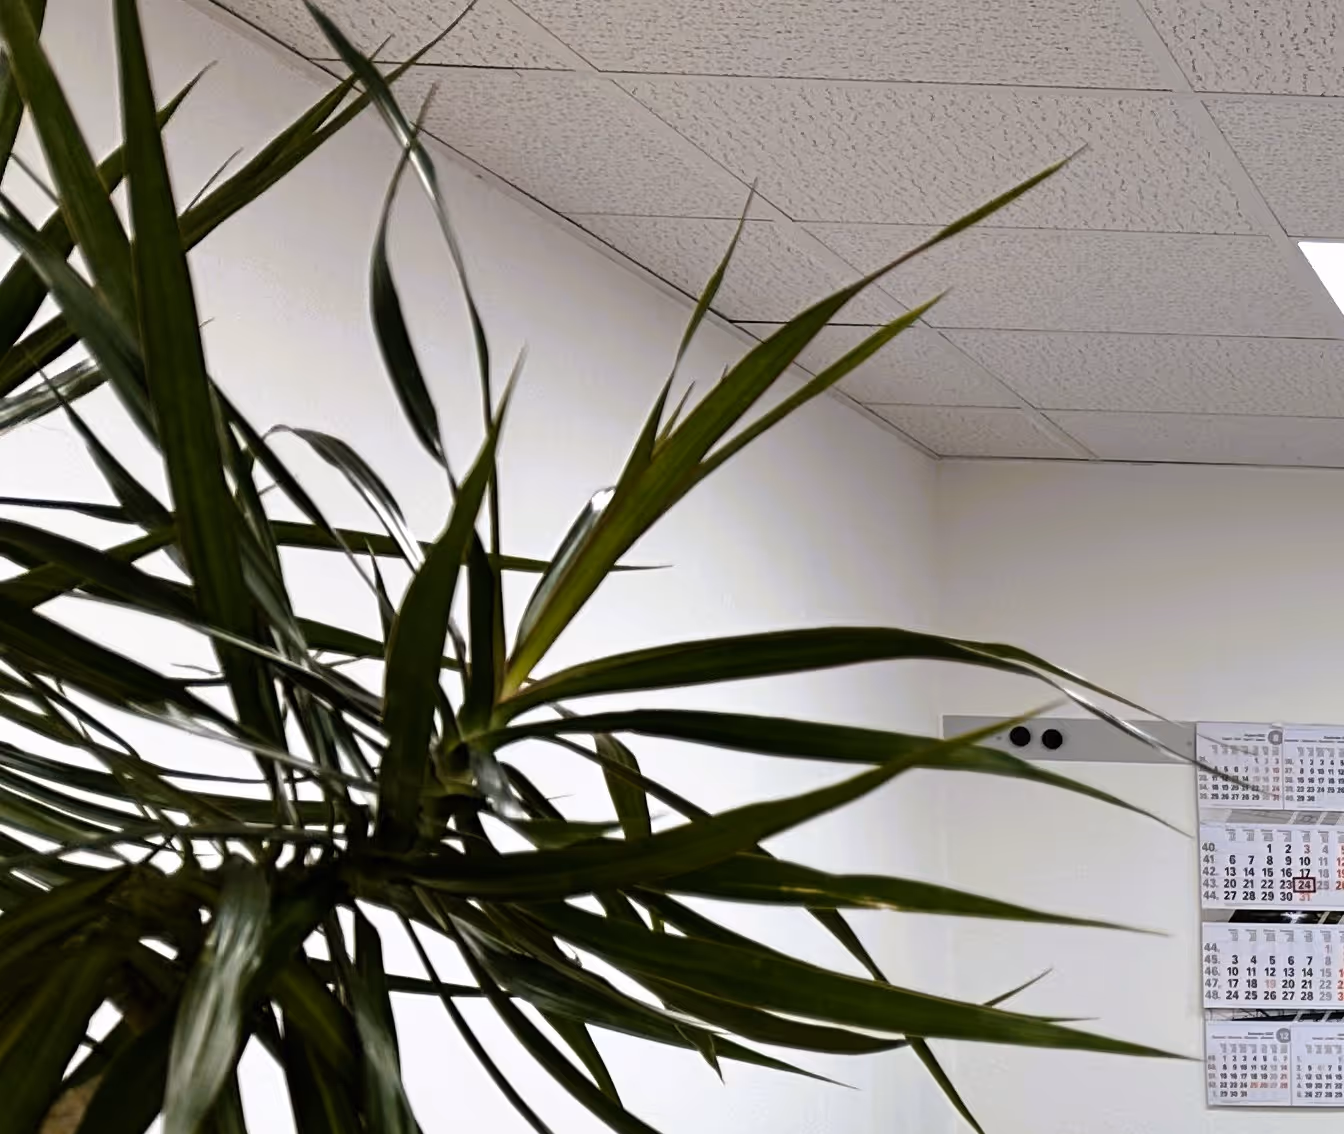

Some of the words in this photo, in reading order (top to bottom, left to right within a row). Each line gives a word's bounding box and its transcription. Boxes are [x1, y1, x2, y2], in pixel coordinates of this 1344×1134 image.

[1267, 844, 1271, 853] 1
[1285, 844, 1291, 854] 2
[1304, 844, 1311, 854] 3
[1229, 855, 1236, 865] 6
[1248, 855, 1254, 865] 7
[1266, 855, 1273, 865] 8
[1285, 856, 1292, 866] 9
[1299, 856, 1311, 866] 10
[1225, 867, 1236, 877] 13
[1244, 867, 1255, 876] 14
[1262, 868, 1274, 877] 15
[1281, 868, 1292, 878] 16
[1298, 868, 1311, 878] 17
[1224, 878, 1237, 888] 20
[1243, 879, 1254, 888] 21
[1261, 879, 1274, 889] 22
[1280, 879, 1293, 889] 23
[1298, 880, 1311, 889] 24
[1224, 891, 1237, 900] 27
[1242, 891, 1256, 901] 28
[1261, 891, 1274, 901] 29
[1280, 891, 1293, 901] 30
[1232, 955, 1238, 965] 3
[1250, 955, 1257, 964] 4
[1269, 955, 1276, 965] 5
[1288, 956, 1295, 965] 6
[1307, 956, 1313, 965] 7
[1227, 967, 1239, 976] 10
[1246, 967, 1256, 976] 11
[1265, 967, 1276, 977] 12
[1283, 967, 1295, 977] 13
[1302, 968, 1313, 977] 14
[1228, 979, 1239, 988] 17
[1246, 979, 1257, 988] 18
[1282, 979, 1295, 989] 20
[1301, 979, 1312, 989] 21
[1226, 990, 1239, 1000] 24
[1245, 991, 1258, 1000] 25
[1264, 991, 1277, 1000] 26
[1282, 991, 1295, 1000] 27
[1300, 991, 1314, 1001] 28
